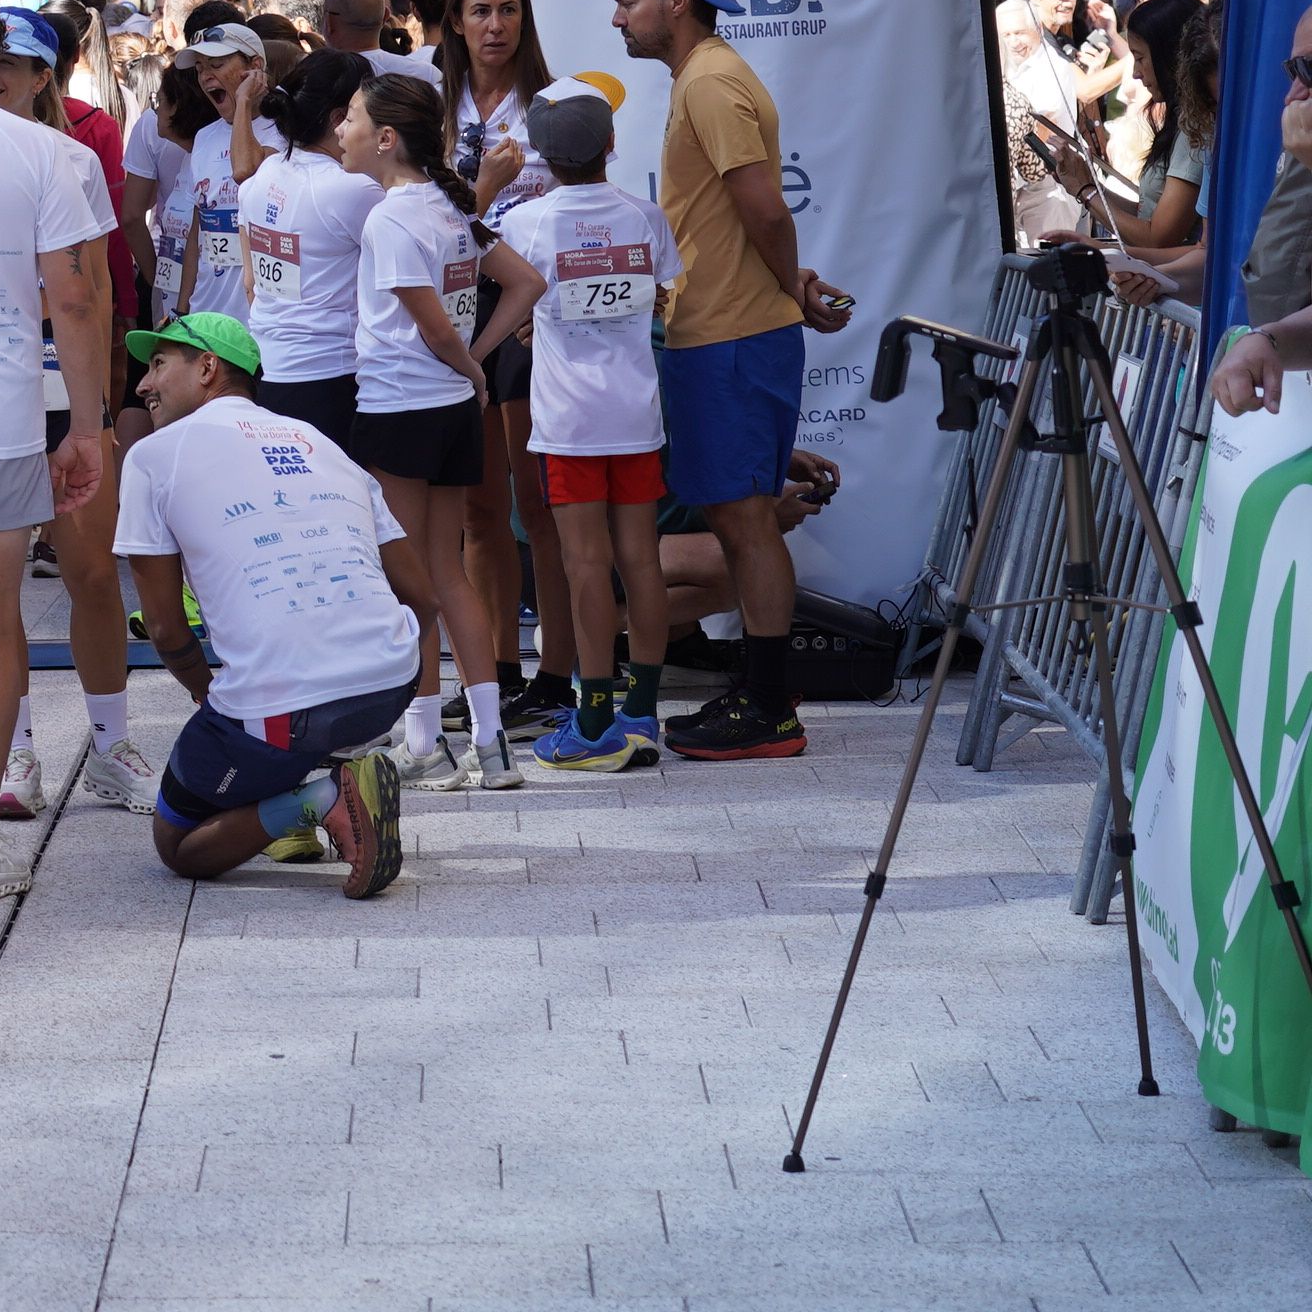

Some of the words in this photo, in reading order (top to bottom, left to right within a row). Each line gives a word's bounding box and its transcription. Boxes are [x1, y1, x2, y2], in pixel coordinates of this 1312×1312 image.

[792, 19, 826, 36] GRUP
[512, 183, 533, 194] Dona
[259, 257, 282, 282] 616
[586, 281, 632, 307] 752
[245, 431, 255, 439] de
[262, 446, 300, 455] CADA
[265, 455, 305, 465] PAS
[273, 466, 312, 476] SUMA
[319, 493, 347, 501] MORA
